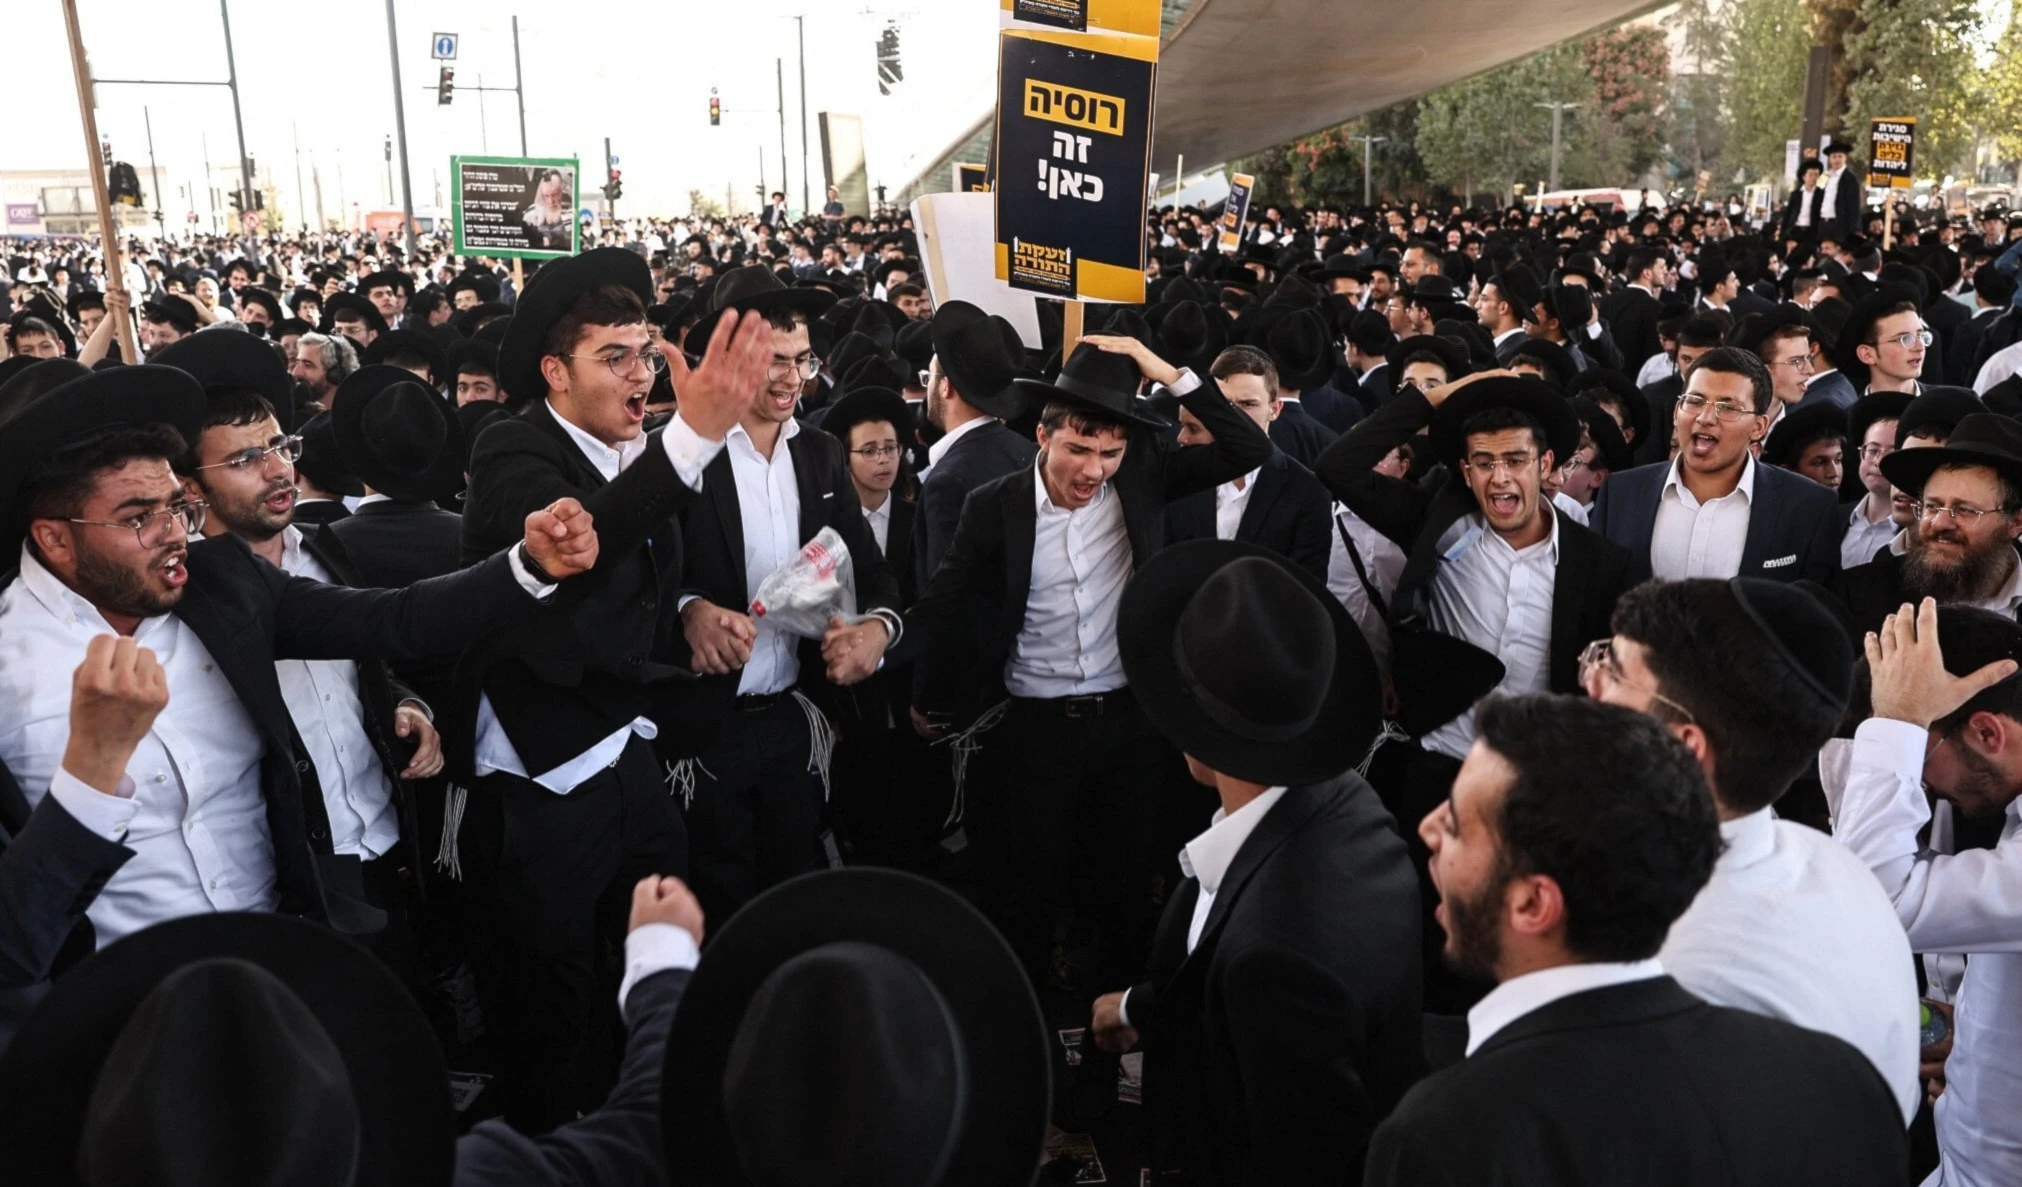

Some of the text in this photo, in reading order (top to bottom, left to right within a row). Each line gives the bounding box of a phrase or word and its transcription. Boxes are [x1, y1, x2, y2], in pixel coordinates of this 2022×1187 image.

[1030, 85, 1119, 129] רוסיה
[1872, 132, 1912, 144] הישיבות
[1878, 123, 1907, 134] סגירת
[1052, 130, 1092, 164] זה
[1880, 150, 1902, 159] כליה
[1873, 159, 1907, 170] ליהדות
[1037, 158, 1104, 202] כאן!
[1019, 240, 1066, 261] זעקת
[1014, 254, 1070, 276] התורה
